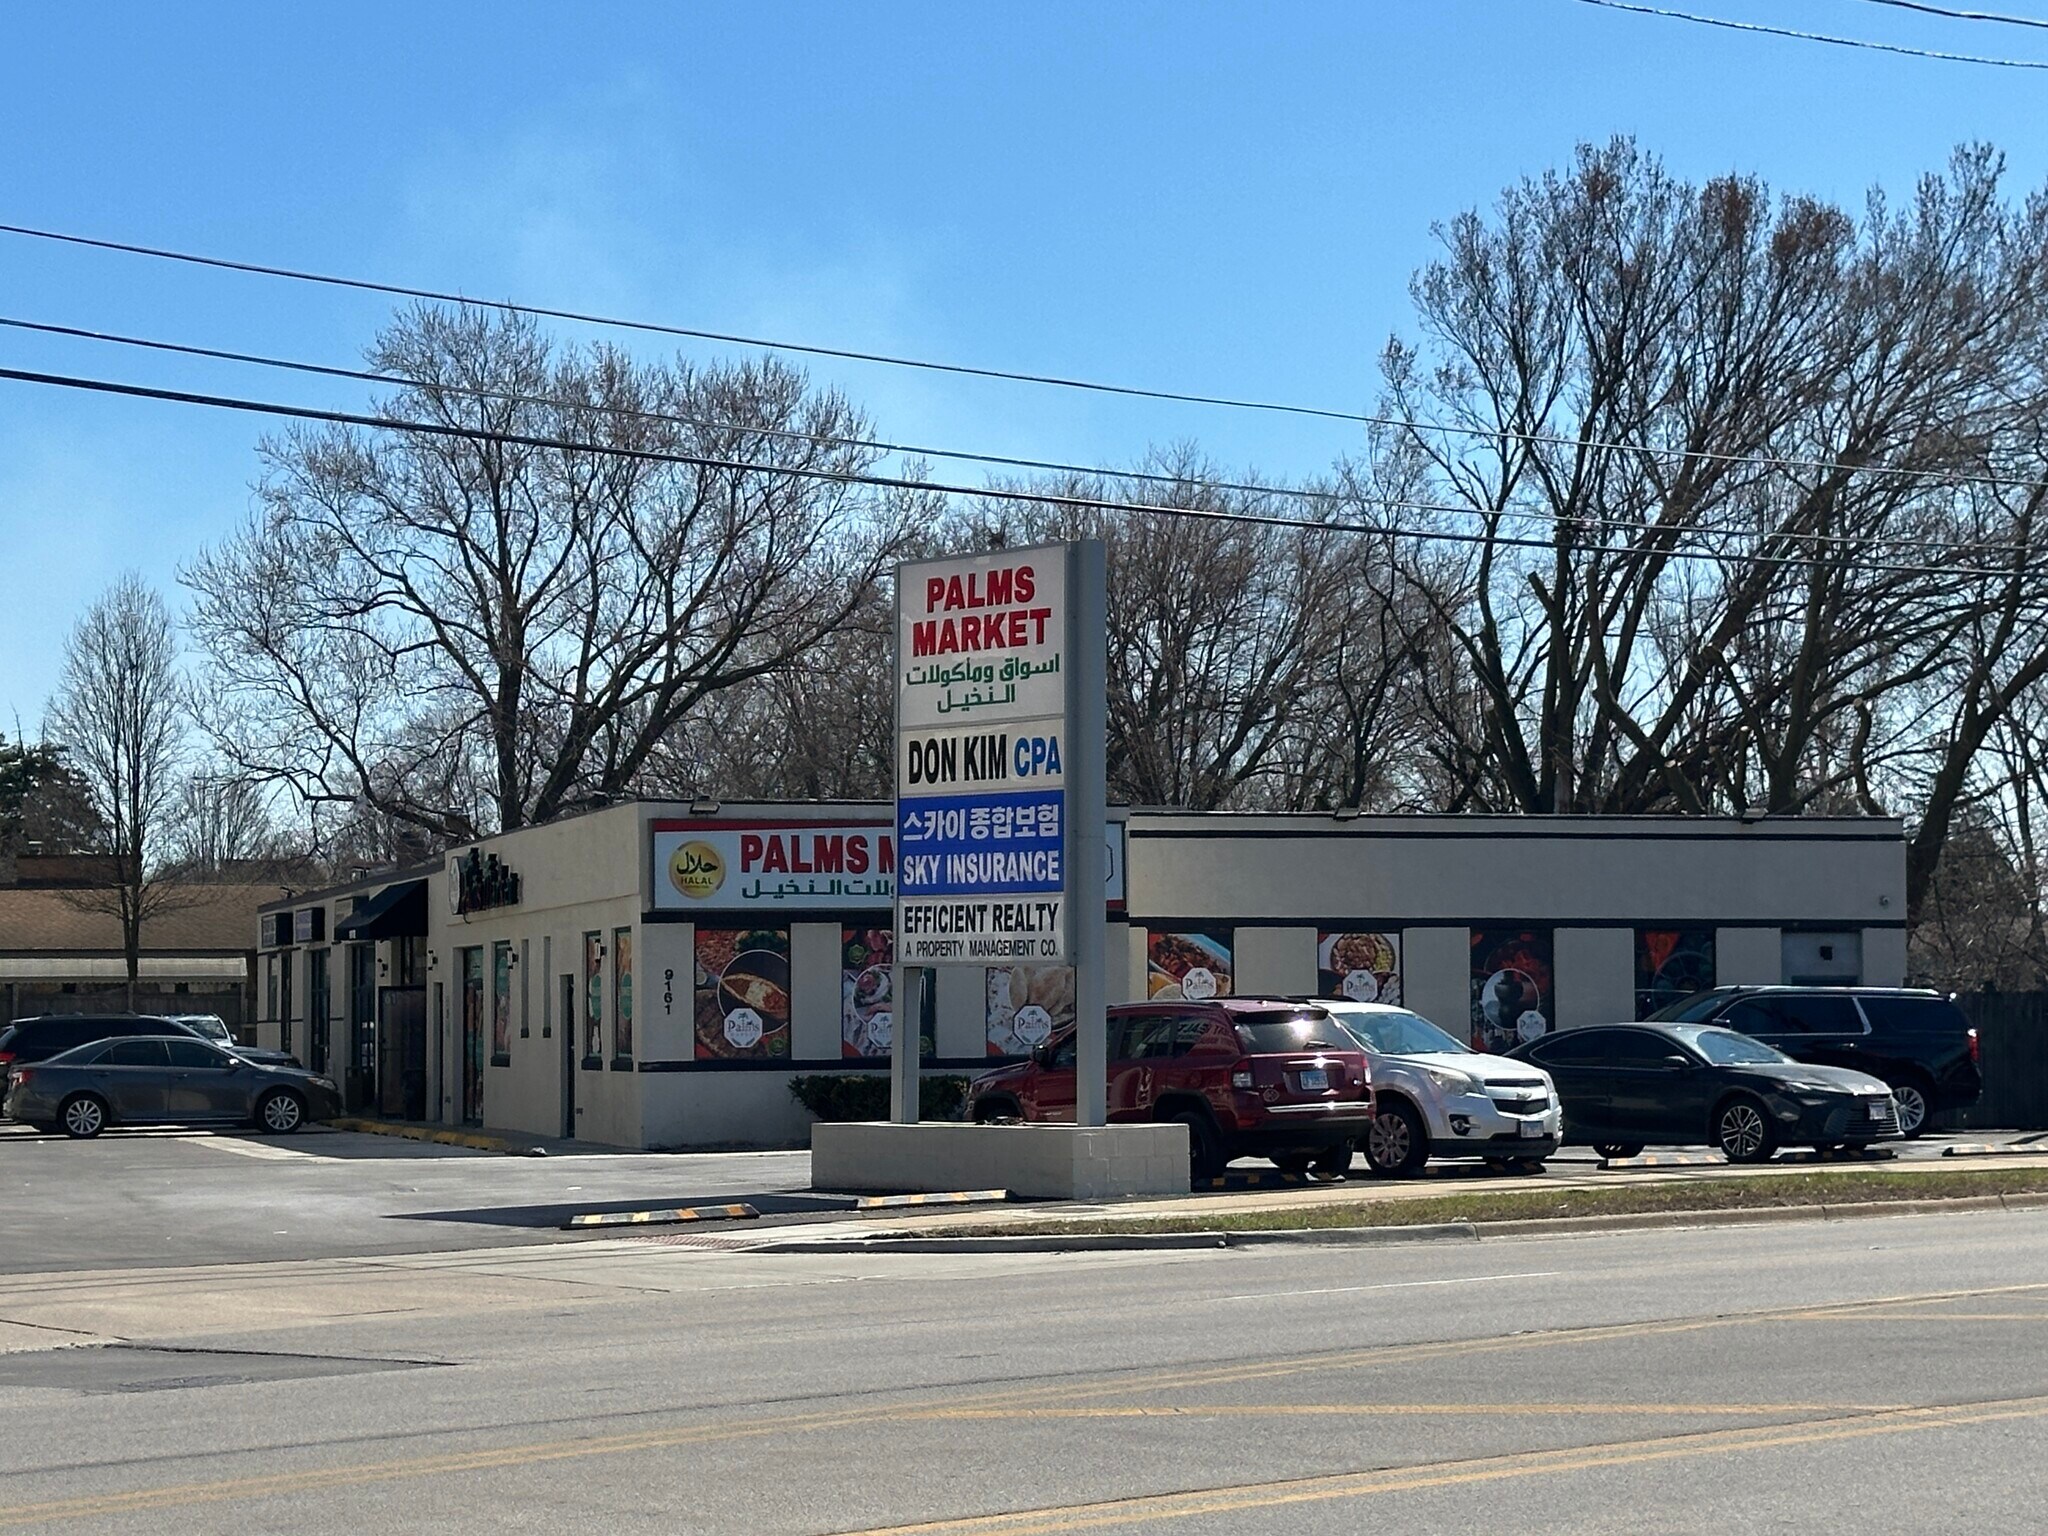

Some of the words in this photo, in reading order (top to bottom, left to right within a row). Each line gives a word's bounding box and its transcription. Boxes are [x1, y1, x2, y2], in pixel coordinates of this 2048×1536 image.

[926, 565, 1036, 613] PALMS
[912, 608, 1052, 658] MARKET
[937, 683, 1016, 714] النخيل
[908, 737, 957, 784] DON
[964, 734, 1008, 781] KIM
[1014, 736, 1062, 777] CPA
[676, 851, 718, 875] حلال
[740, 833, 869, 874] PALMS
[903, 853, 941, 885] SKY
[946, 850, 1060, 885] INSURANCE
[681, 876, 714, 885] HALAL
[741, 878, 842, 899] النخيل
[904, 904, 988, 934] EFFICIENT
[992, 902, 1059, 933] REALTY
[905, 941, 912, 958] A
[916, 940, 965, 958] PROPERTY
[969, 939, 1036, 957] MANAGEMENT
[1041, 939, 1058, 956] CO.
[664, 969, 674, 1015] 9161
